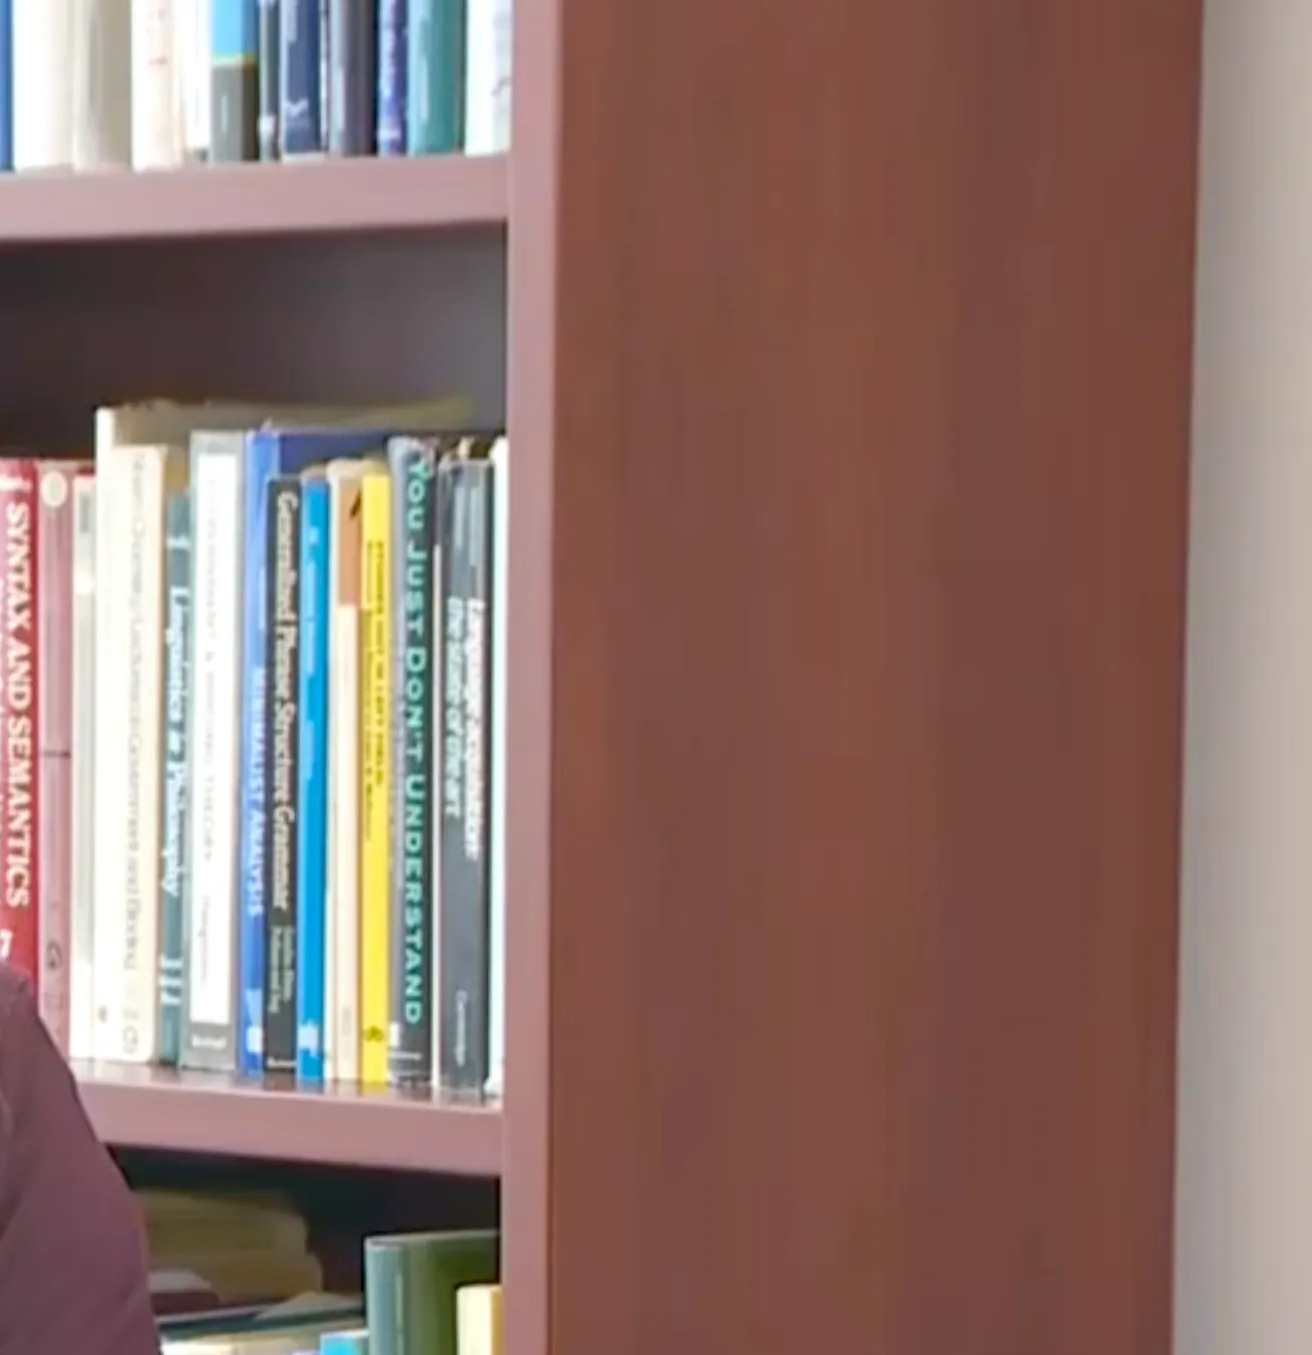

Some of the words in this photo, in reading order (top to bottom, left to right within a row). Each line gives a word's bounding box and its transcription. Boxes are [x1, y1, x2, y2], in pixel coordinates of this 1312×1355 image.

[407, 458, 431, 534] YOU
[6, 502, 31, 629] SYNTAX
[273, 489, 299, 621] Generalized
[406, 539, 429, 635] JUST
[7, 635, 31, 708] AND
[165, 586, 192, 722] Linguistics
[272, 624, 297, 702] Phrase
[406, 645, 428, 760] DON'T
[272, 703, 296, 804] Structure
[446, 784, 462, 821] art
[6, 715, 31, 907] SEMANTICS
[161, 761, 190, 898] Philosophy
[270, 806, 294, 911] Grammar
[403, 771, 427, 1026] UNDERSTAND
